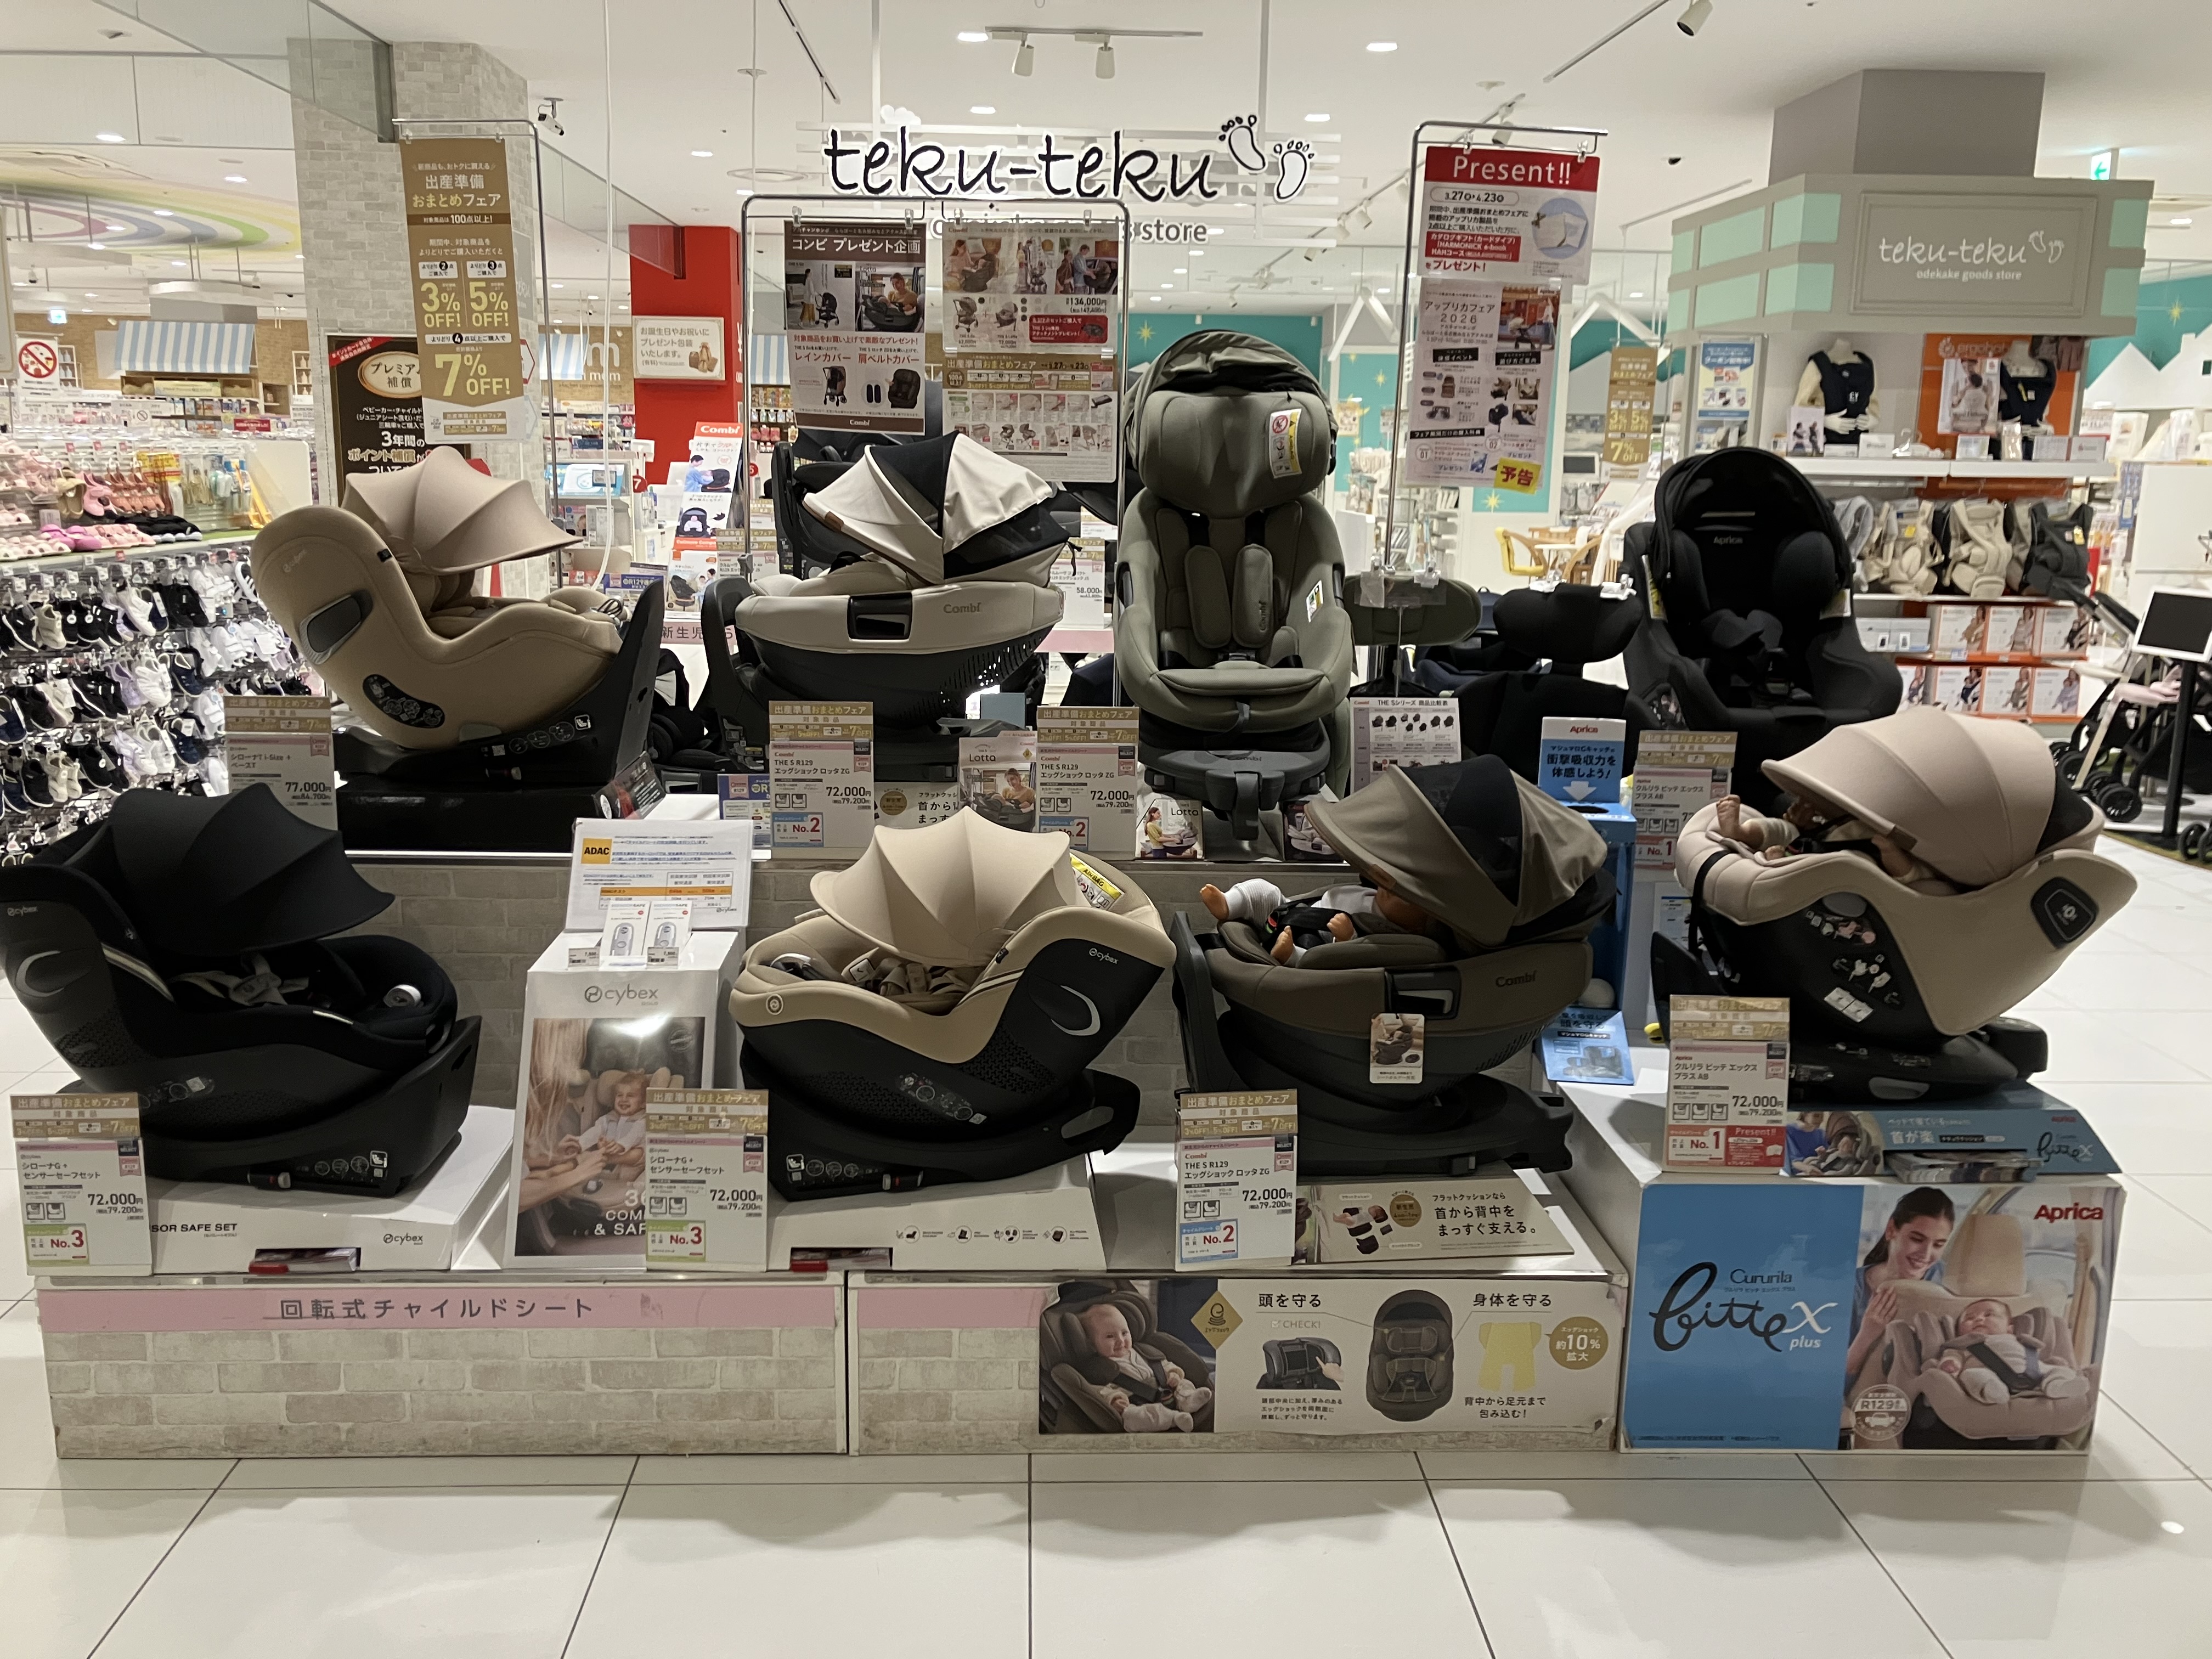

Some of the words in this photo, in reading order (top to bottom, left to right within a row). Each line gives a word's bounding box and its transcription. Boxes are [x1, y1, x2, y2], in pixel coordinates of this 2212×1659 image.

[823, 125, 1218, 202] teku-teku
[1453, 155, 1570, 184] Present!!
[426, 174, 484, 189] 出産準備
[413, 194, 500, 208] おまとめフェア
[1142, 221, 1206, 242] store
[792, 238, 827, 251] コンビ
[834, 238, 920, 254] プレゼント企画
[1880, 236, 2027, 264] teku-teku
[1916, 269, 1959, 280] odekake
[1962, 269, 1993, 282] goods
[1996, 270, 2022, 280] store
[421, 282, 460, 312] 3%
[469, 281, 508, 311] 5%
[1424, 302, 1495, 313] アップリカフェア
[424, 313, 461, 328] OFF!
[472, 312, 509, 326] OFF!
[641, 328, 709, 336] お誕生日やお祝いに
[641, 338, 693, 347] プレゼント包装
[641, 350, 681, 358] いたします。
[795, 352, 851, 362] レインカバー
[859, 353, 919, 364] 肩ベルトカバー
[387, 377, 411, 388] 補償
[466, 379, 510, 395] OFF!
[700, 425, 741, 434] Combi
[381, 430, 425, 447] 3年間の
[1500, 465, 1534, 487] 予告
[944, 602, 981, 613] Combi
[775, 706, 866, 714] 出産準備おまとめフェア
[1043, 710, 1132, 719] 出産準備おまとめフェア
[1570, 725, 1598, 734] Aprica
[1547, 754, 1616, 766] 衝撃吸収力を
[1552, 768, 1611, 780] 体感しよう!
[285, 782, 331, 792] 77,000円
[826, 787, 871, 797] 72,000円
[1091, 791, 1134, 800] 72,000円
[1171, 808, 1198, 816] Lotta
[793, 817, 820, 833] No.2
[584, 847, 610, 855] ADAC
[1647, 841, 1672, 856] No.1
[1083, 868, 1104, 887] AIRBAG
[1097, 951, 1119, 964] cybex
[1496, 972, 1536, 988] Combi
[605, 984, 658, 1006] cybex
[18, 1098, 129, 1109] 出産準備おまとめフェア
[1187, 1094, 1289, 1108] 出産準備おまとめフェア
[1733, 1096, 1784, 1108] 72,000円
[1690, 1131, 1720, 1149] No.1
[1184, 1170, 1234, 1180] エッグショック
[1237, 1169, 1257, 1177] ロッタ
[88, 1193, 143, 1206] 72,000円
[710, 1189, 763, 1201] 72,000円
[1243, 1188, 1293, 1202] 72,000円
[1432, 1192, 1505, 1202] フラットクッションなら
[1434, 1205, 1515, 1220] 首から背中を
[2034, 1203, 2104, 1223] Aprica
[594, 1224, 605, 1235] &
[670, 1226, 702, 1244] No.3
[1203, 1225, 1234, 1245] No.2
[1437, 1222, 1536, 1237] まっすぐ支える。
[51, 1229, 84, 1248] No.3
[394, 1233, 423, 1245] cybex
[1730, 1269, 1792, 1284] Cururila
[1259, 1293, 1321, 1307] 頭を守る
[1473, 1293, 1551, 1307] 身体を守る
[281, 1299, 593, 1320] 回転式チャイルドシート
[1283, 1320, 1321, 1329] CHECK!
[1789, 1335, 1822, 1351] plus
[1566, 1352, 1589, 1362] 拡大
[1465, 1396, 1546, 1406] 背中から足元まで
[1480, 1409, 1526, 1418] 包み込む!
